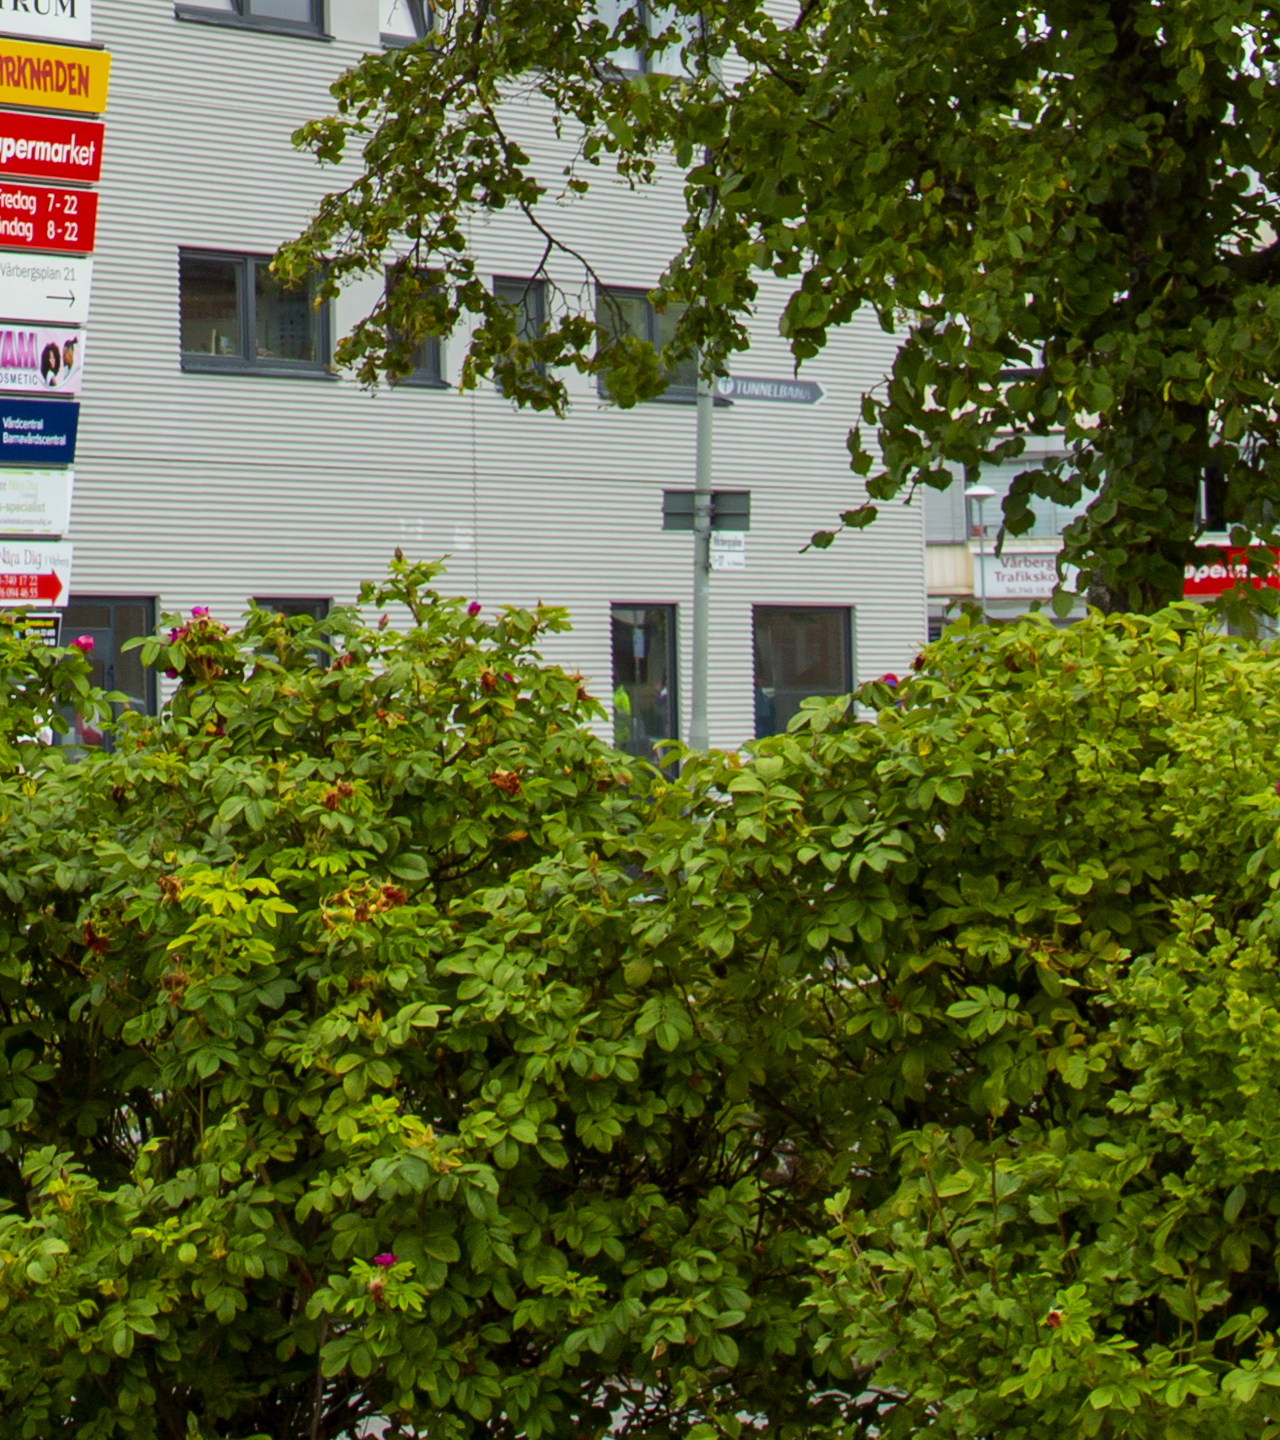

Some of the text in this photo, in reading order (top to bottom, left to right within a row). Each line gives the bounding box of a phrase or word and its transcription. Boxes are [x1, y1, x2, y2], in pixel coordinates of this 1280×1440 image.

[47, 193, 55, 212] 7
[63, 195, 78, 214] 22
[47, 220, 55, 239] 8
[64, 222, 78, 241] 22
[0, 262, 76, 282] Vårbergsplan 21
[736, 381, 811, 399] TUNNELBANA
[24, 549, 41, 569] Dig
[995, 571, 1057, 582] Trafiksko
